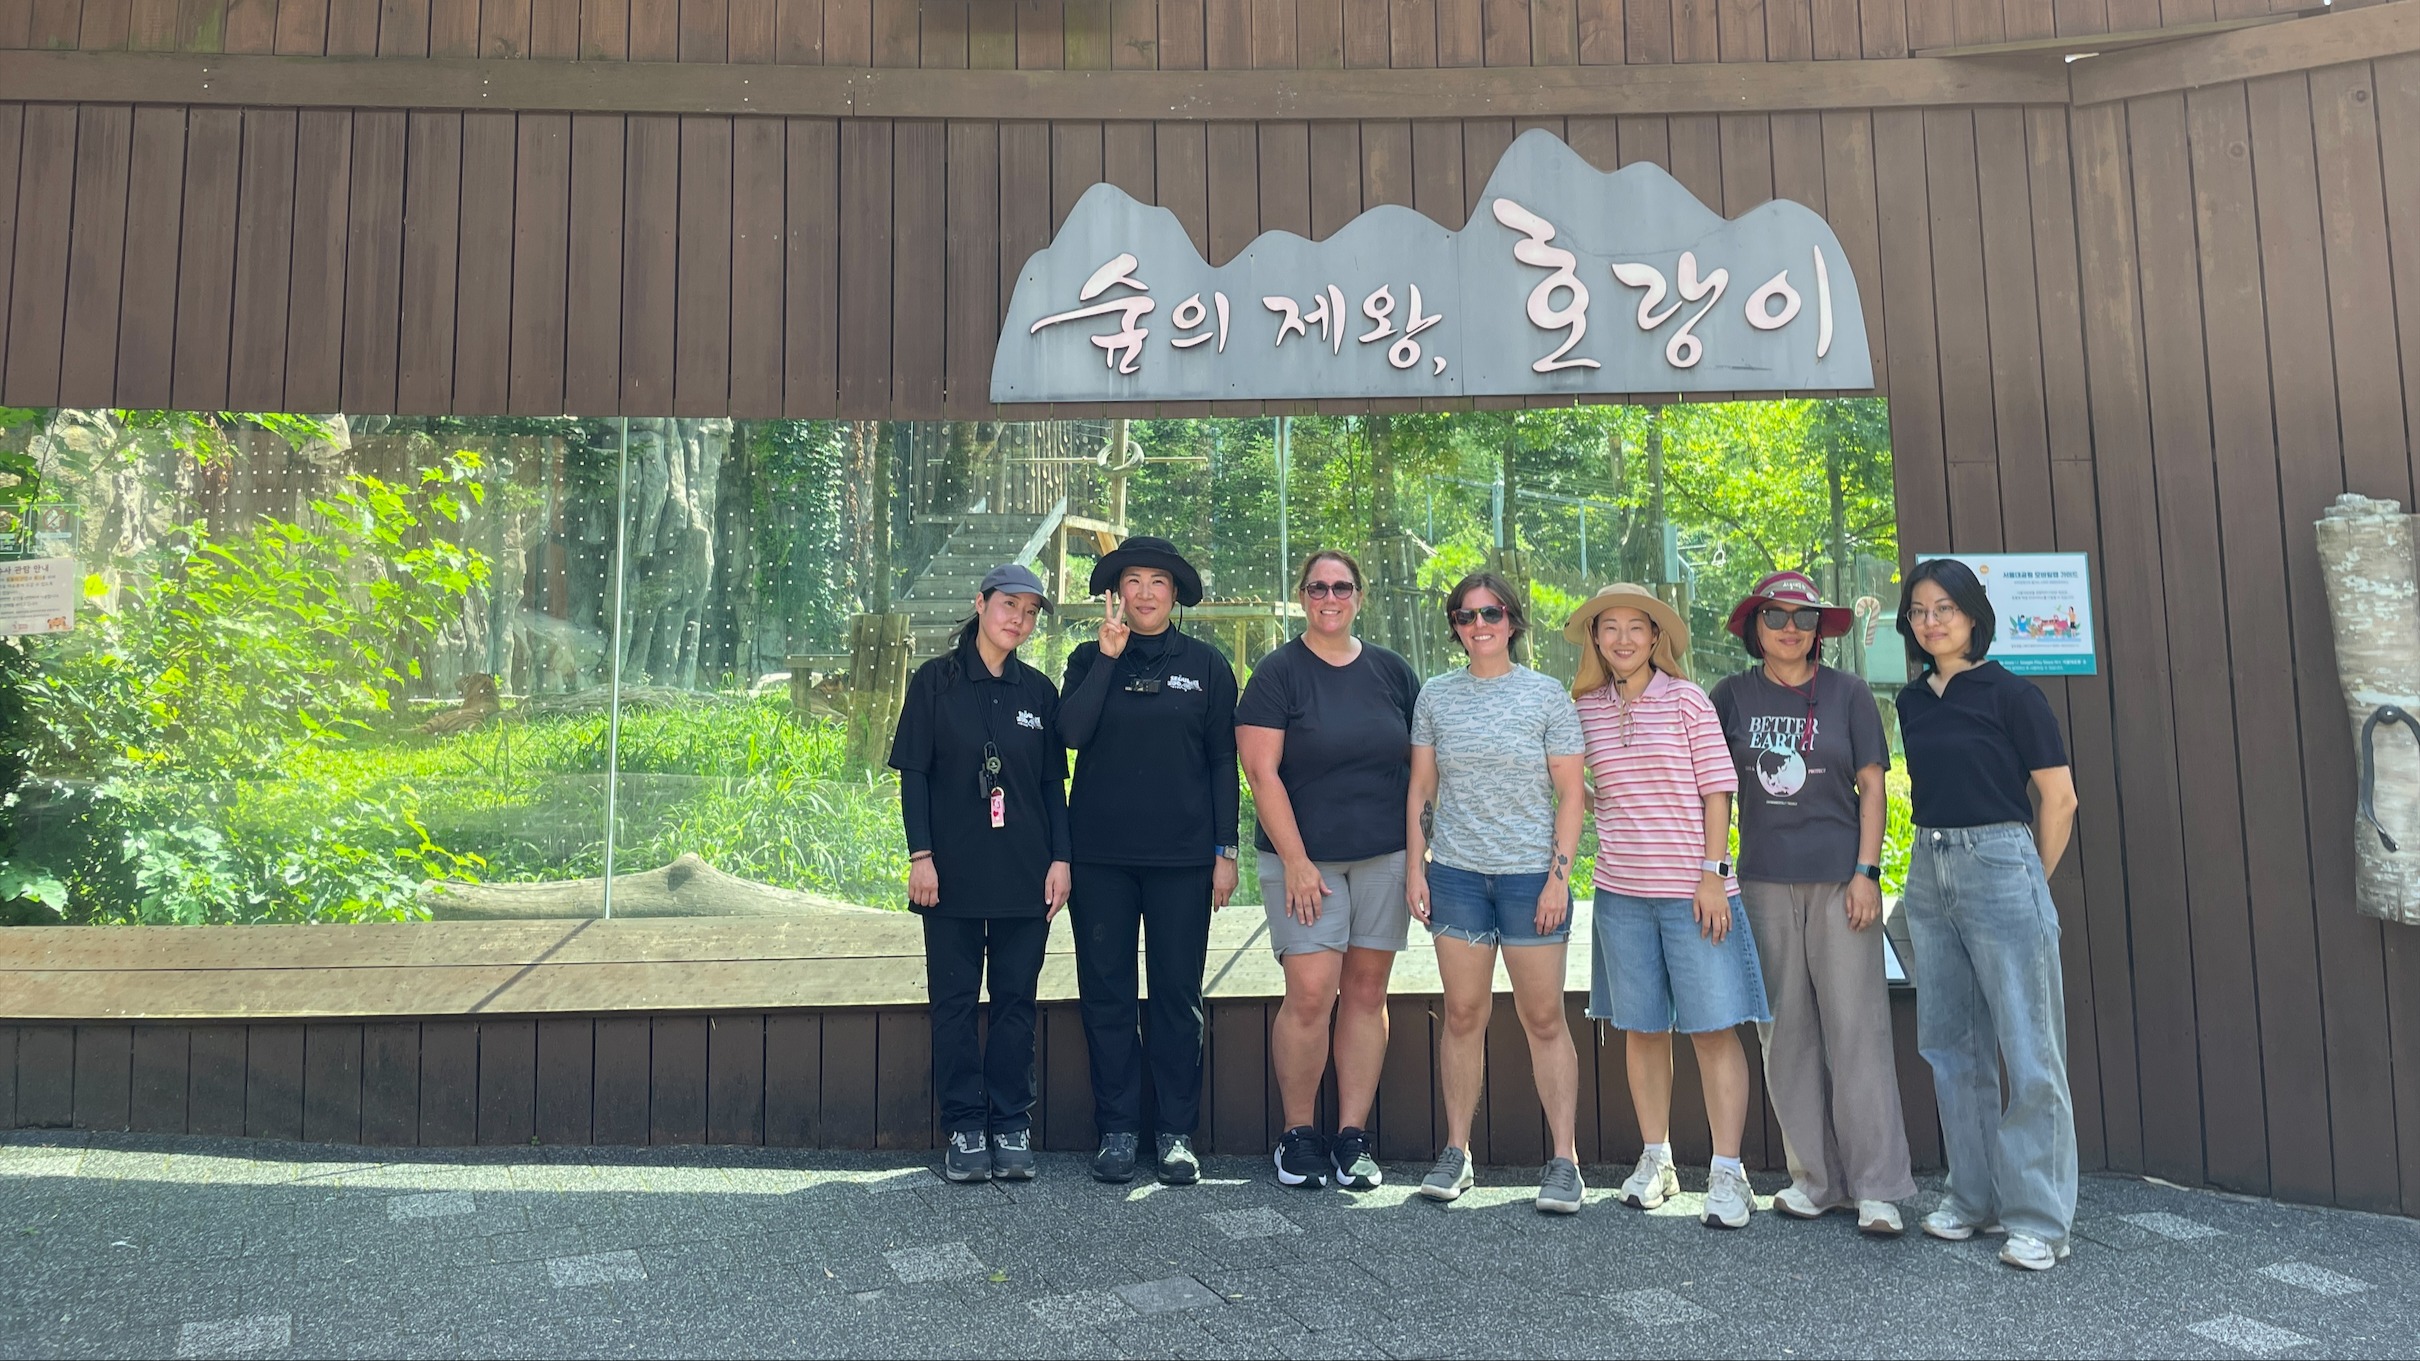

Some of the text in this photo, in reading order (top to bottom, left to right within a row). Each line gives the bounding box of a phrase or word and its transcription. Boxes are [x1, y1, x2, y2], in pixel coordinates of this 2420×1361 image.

[1030, 197, 1833, 377] 숲의 제왕, 호랑이
[14, 565, 31, 574] 관람
[33, 564, 49, 573] 안내
[1749, 716, 1819, 734] BETTER
